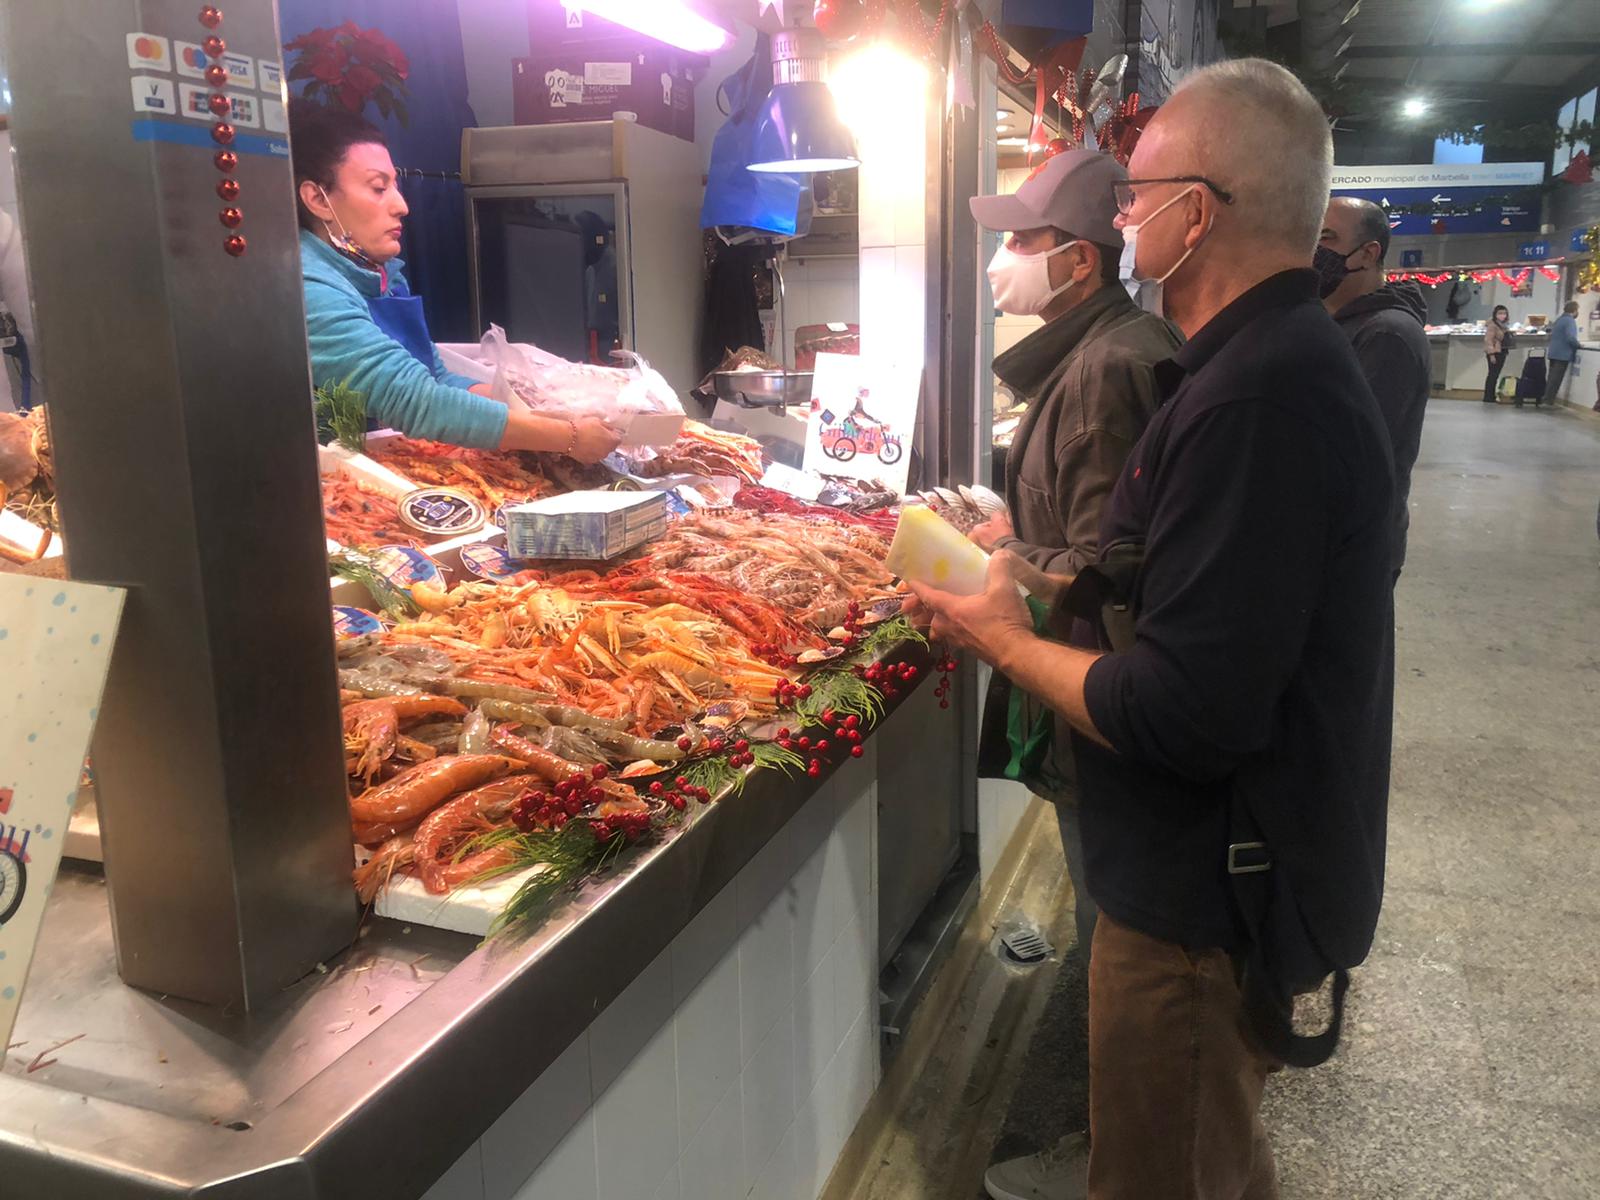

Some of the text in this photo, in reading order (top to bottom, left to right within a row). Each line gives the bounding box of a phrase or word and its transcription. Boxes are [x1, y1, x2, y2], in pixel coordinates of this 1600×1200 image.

[1331, 176, 1372, 184] ERCADO
[1374, 174, 1415, 184] municipal
[1417, 174, 1430, 182] de
[1432, 173, 1469, 181] Marbella
[1536, 246, 1544, 255] 11
